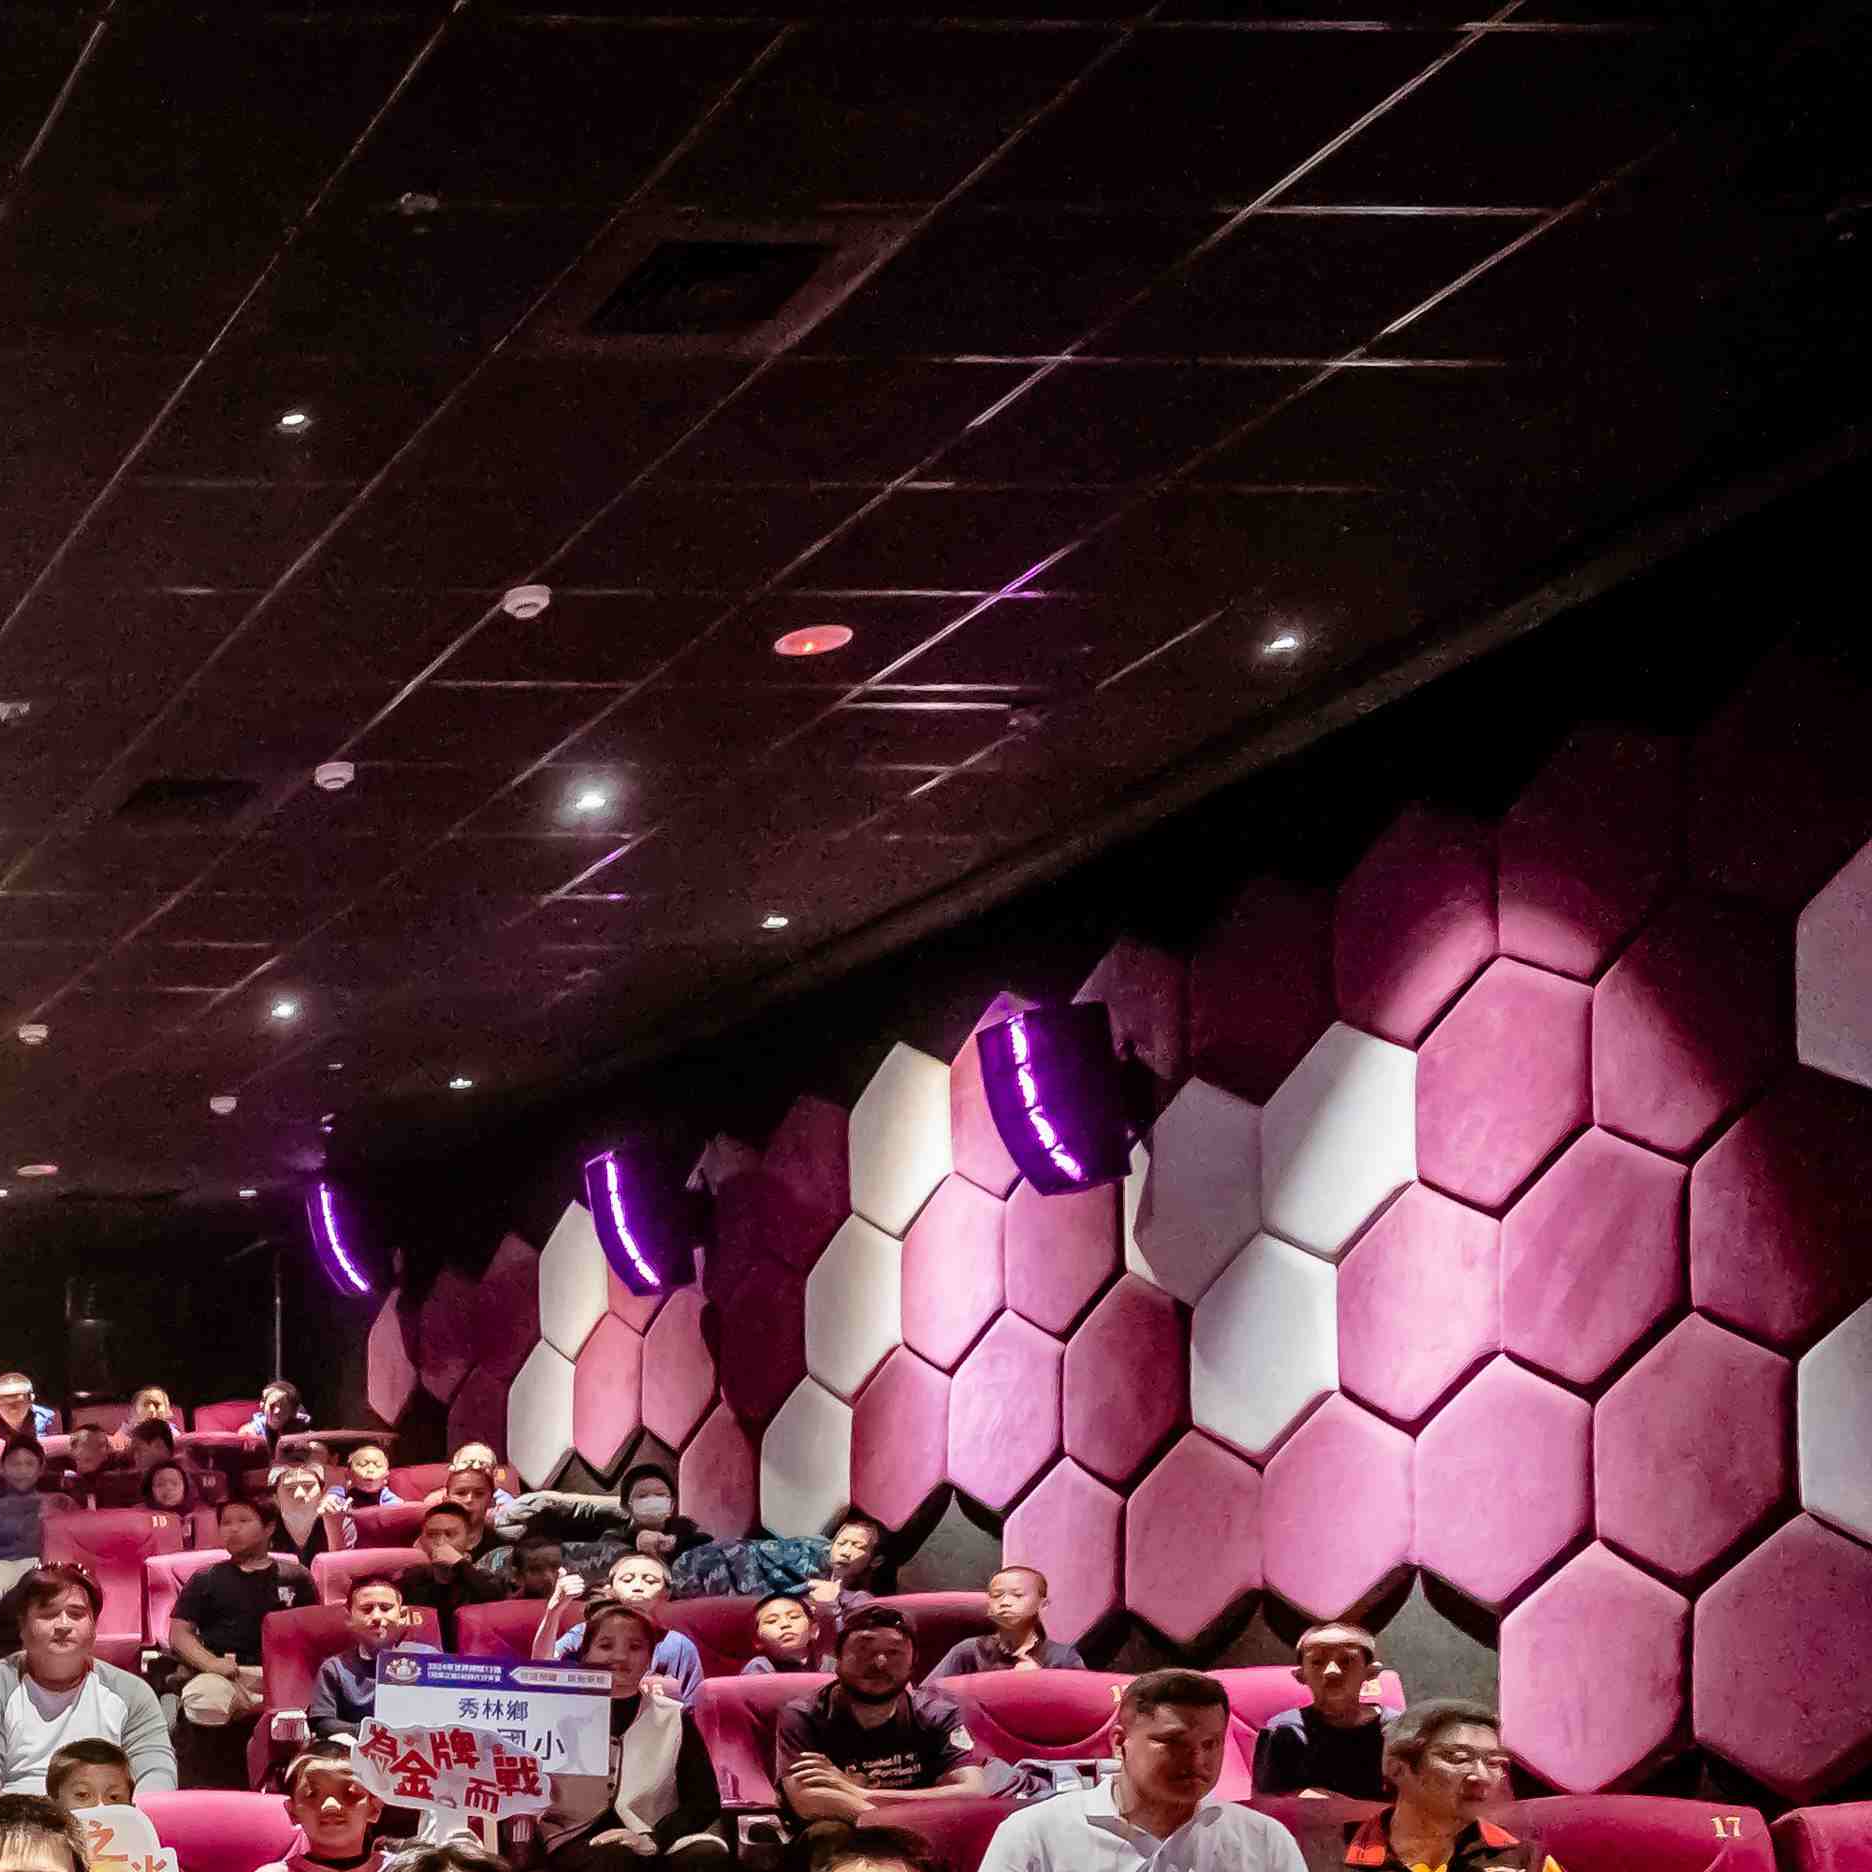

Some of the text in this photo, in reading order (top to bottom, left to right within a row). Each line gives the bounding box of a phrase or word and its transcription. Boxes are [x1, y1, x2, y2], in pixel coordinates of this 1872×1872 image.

[458, 1697, 529, 1721] 秀林鄉
[1711, 1817, 1743, 1840] 17
